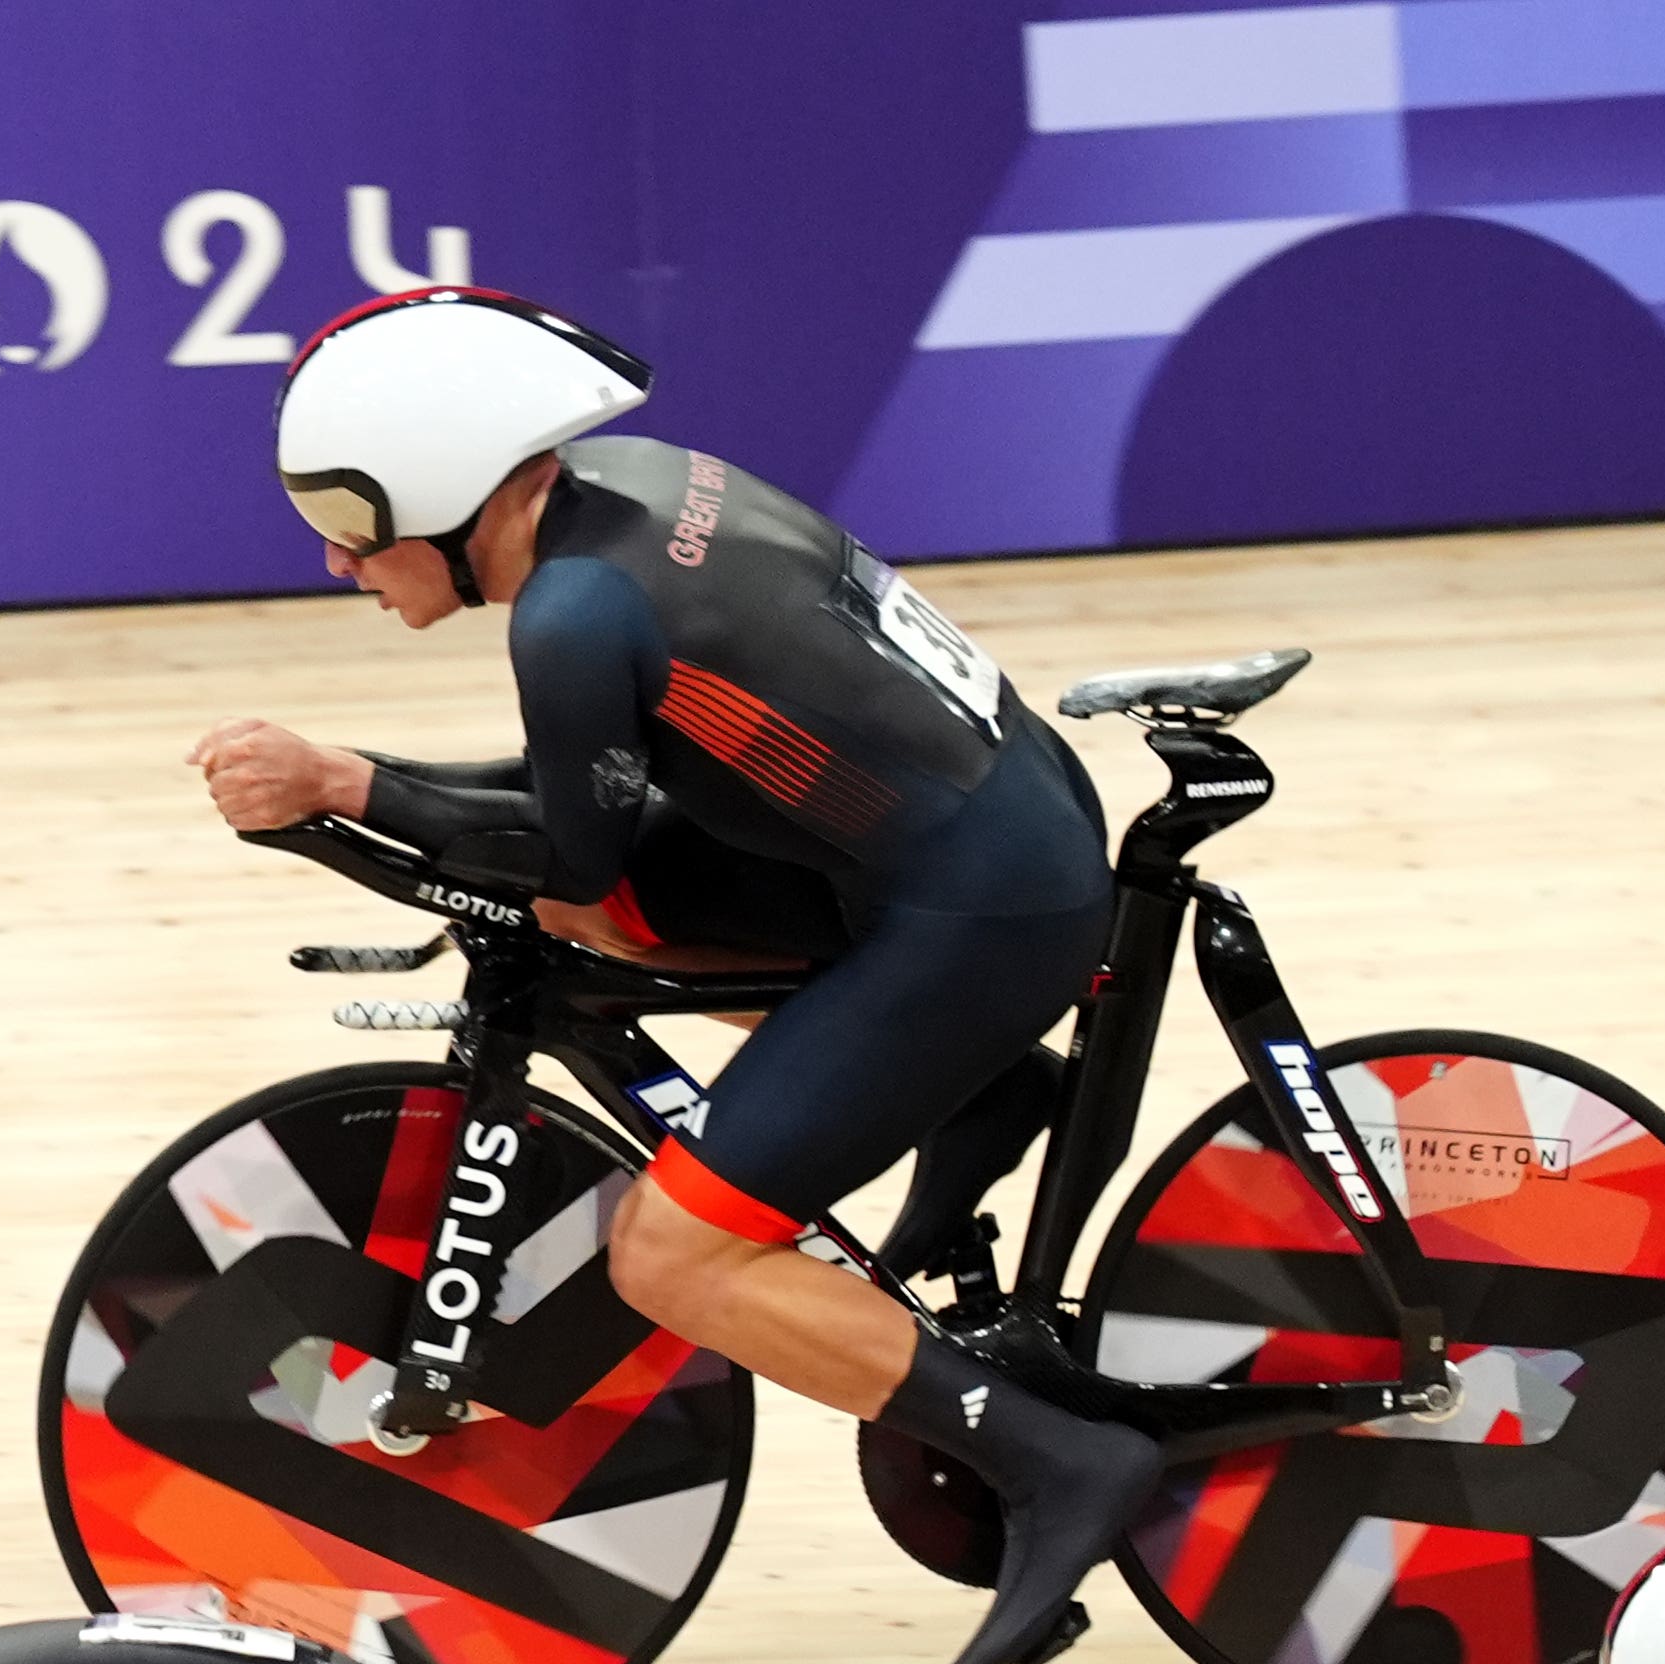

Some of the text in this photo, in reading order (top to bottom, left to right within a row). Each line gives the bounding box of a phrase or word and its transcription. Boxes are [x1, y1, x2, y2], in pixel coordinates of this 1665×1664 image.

[667, 487, 723, 567] GREAT
[894, 592, 974, 680] 30
[431, 884, 524, 926] LOTUS
[1267, 1043, 1383, 1220] hope
[411, 1119, 520, 1364] LOTUS
